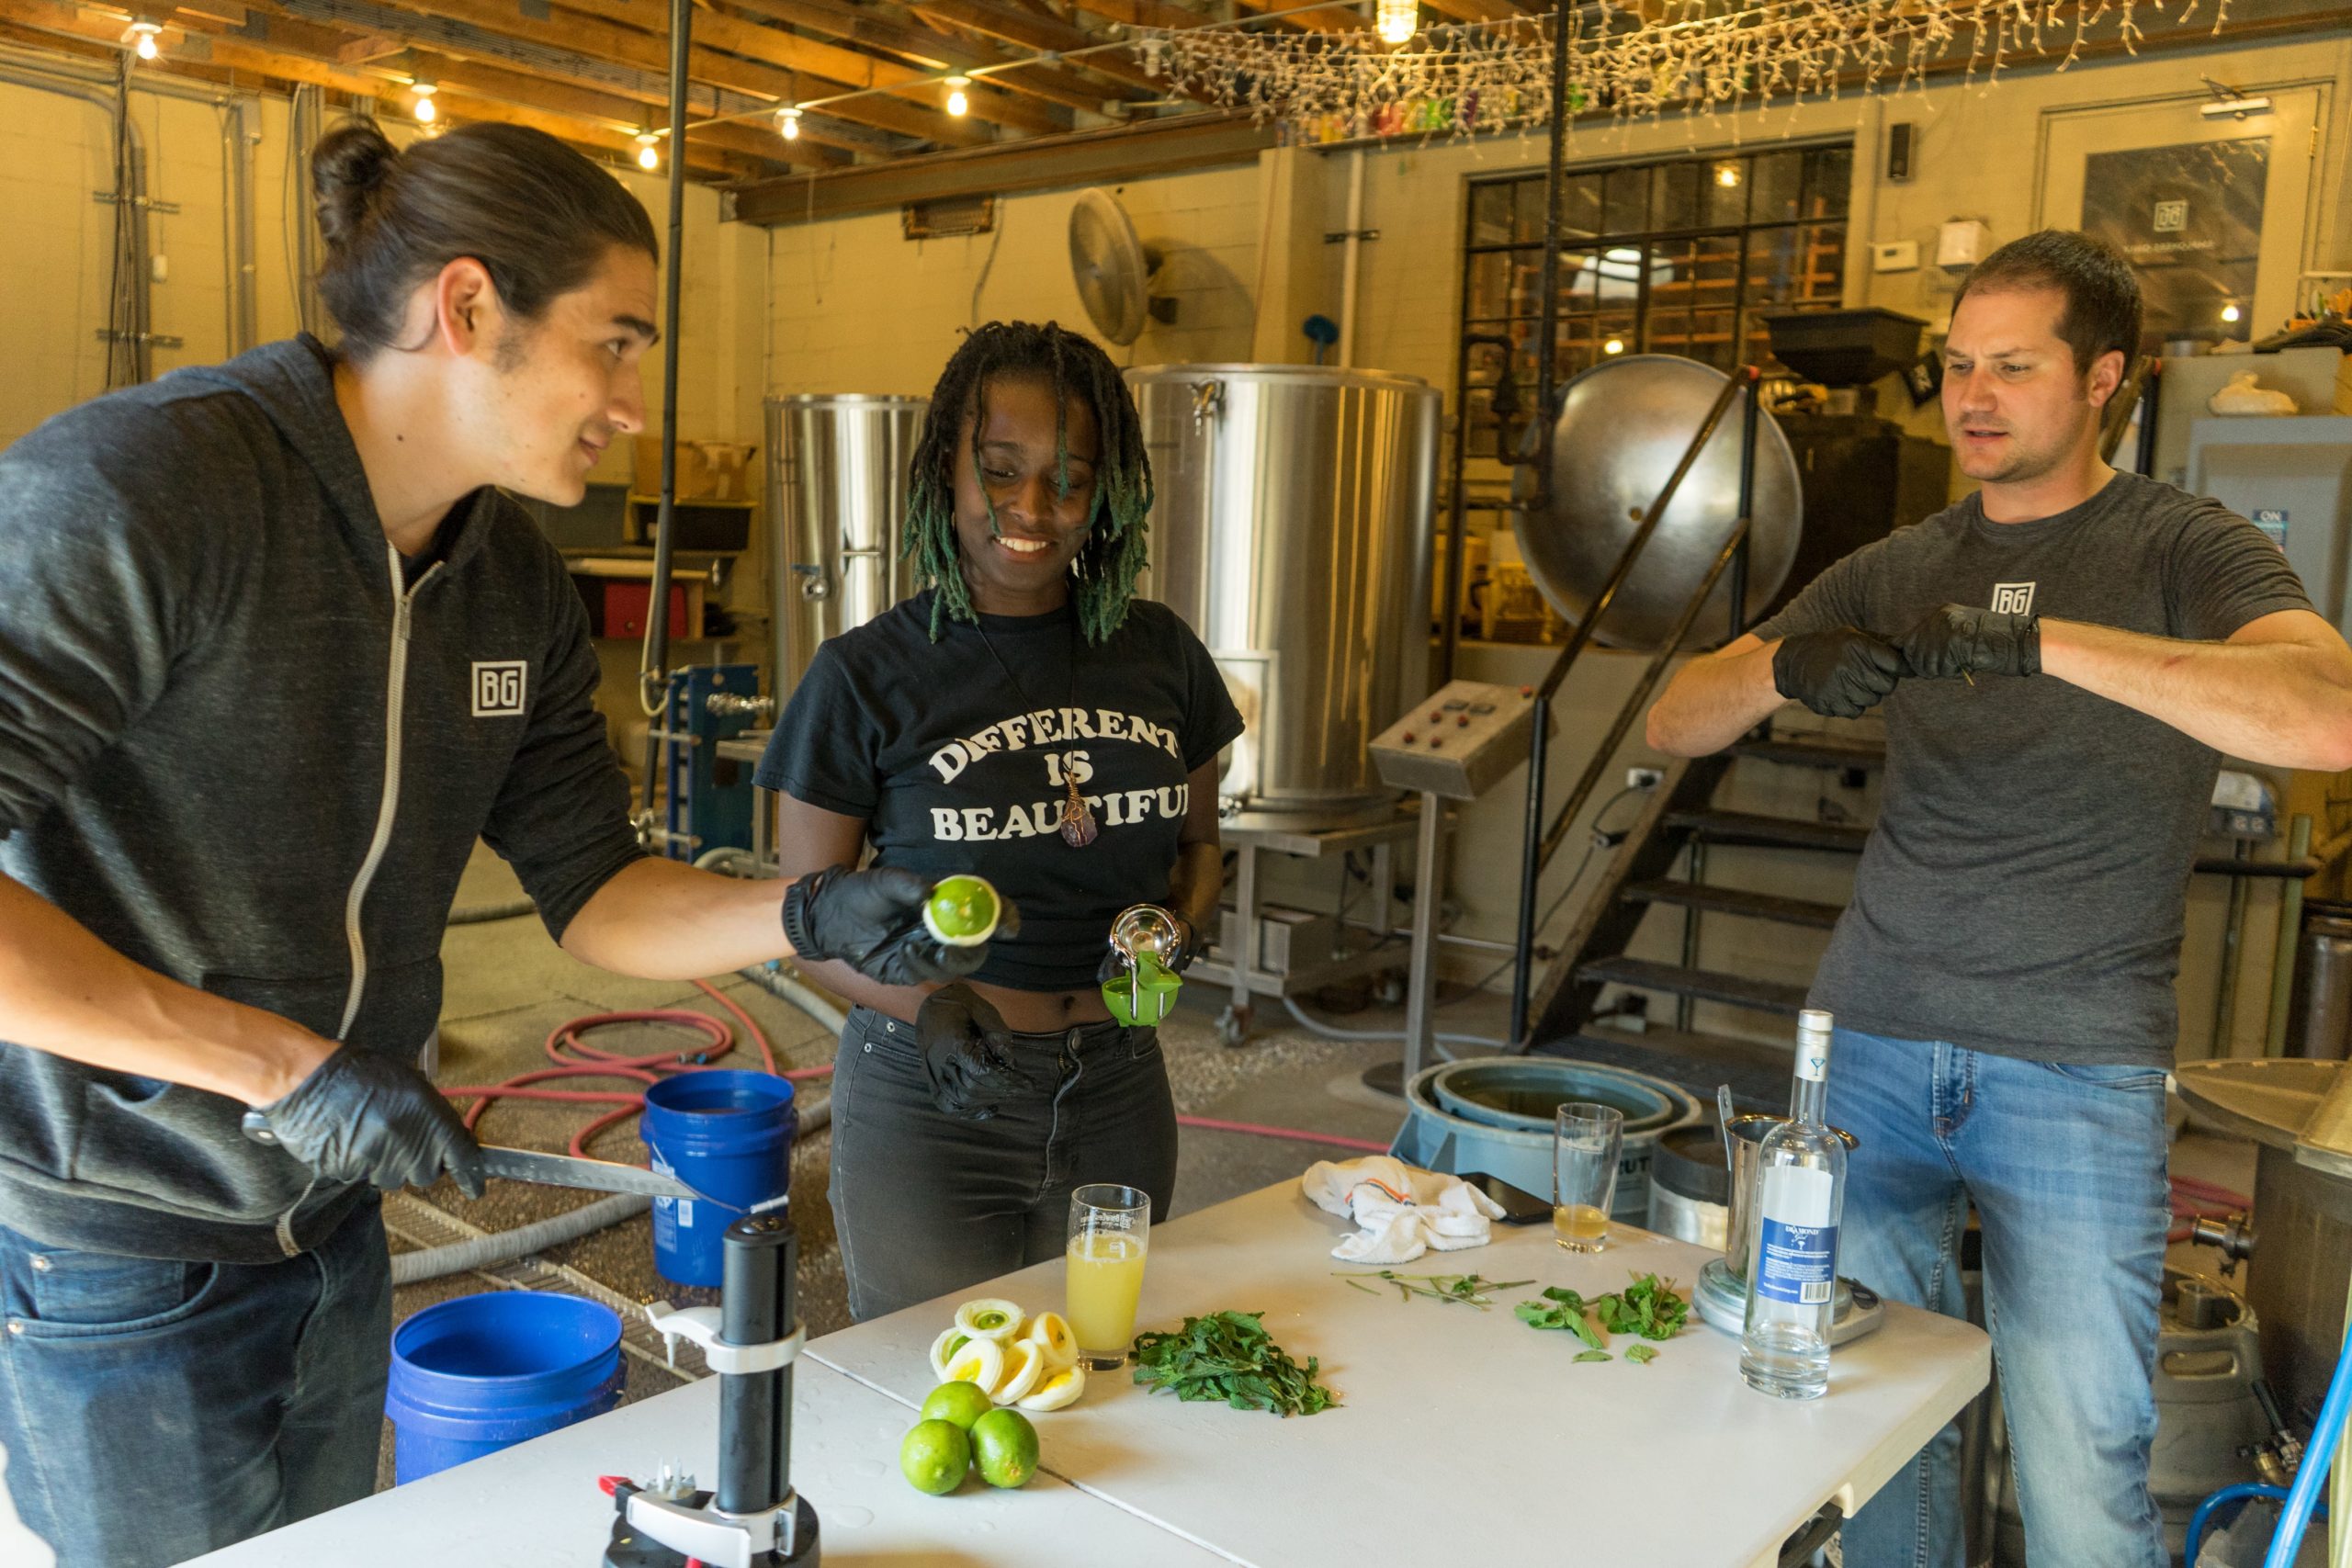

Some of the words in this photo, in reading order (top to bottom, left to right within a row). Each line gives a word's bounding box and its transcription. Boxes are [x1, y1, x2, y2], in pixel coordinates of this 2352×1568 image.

[1996, 588, 2029, 615] BG
[480, 669, 520, 709] BG
[928, 707, 1179, 784] DIFFERENT
[1044, 750, 1094, 786] IS
[930, 784, 1189, 841] BEAUIFU
[1784, 1225, 1820, 1236] DIAMOND
